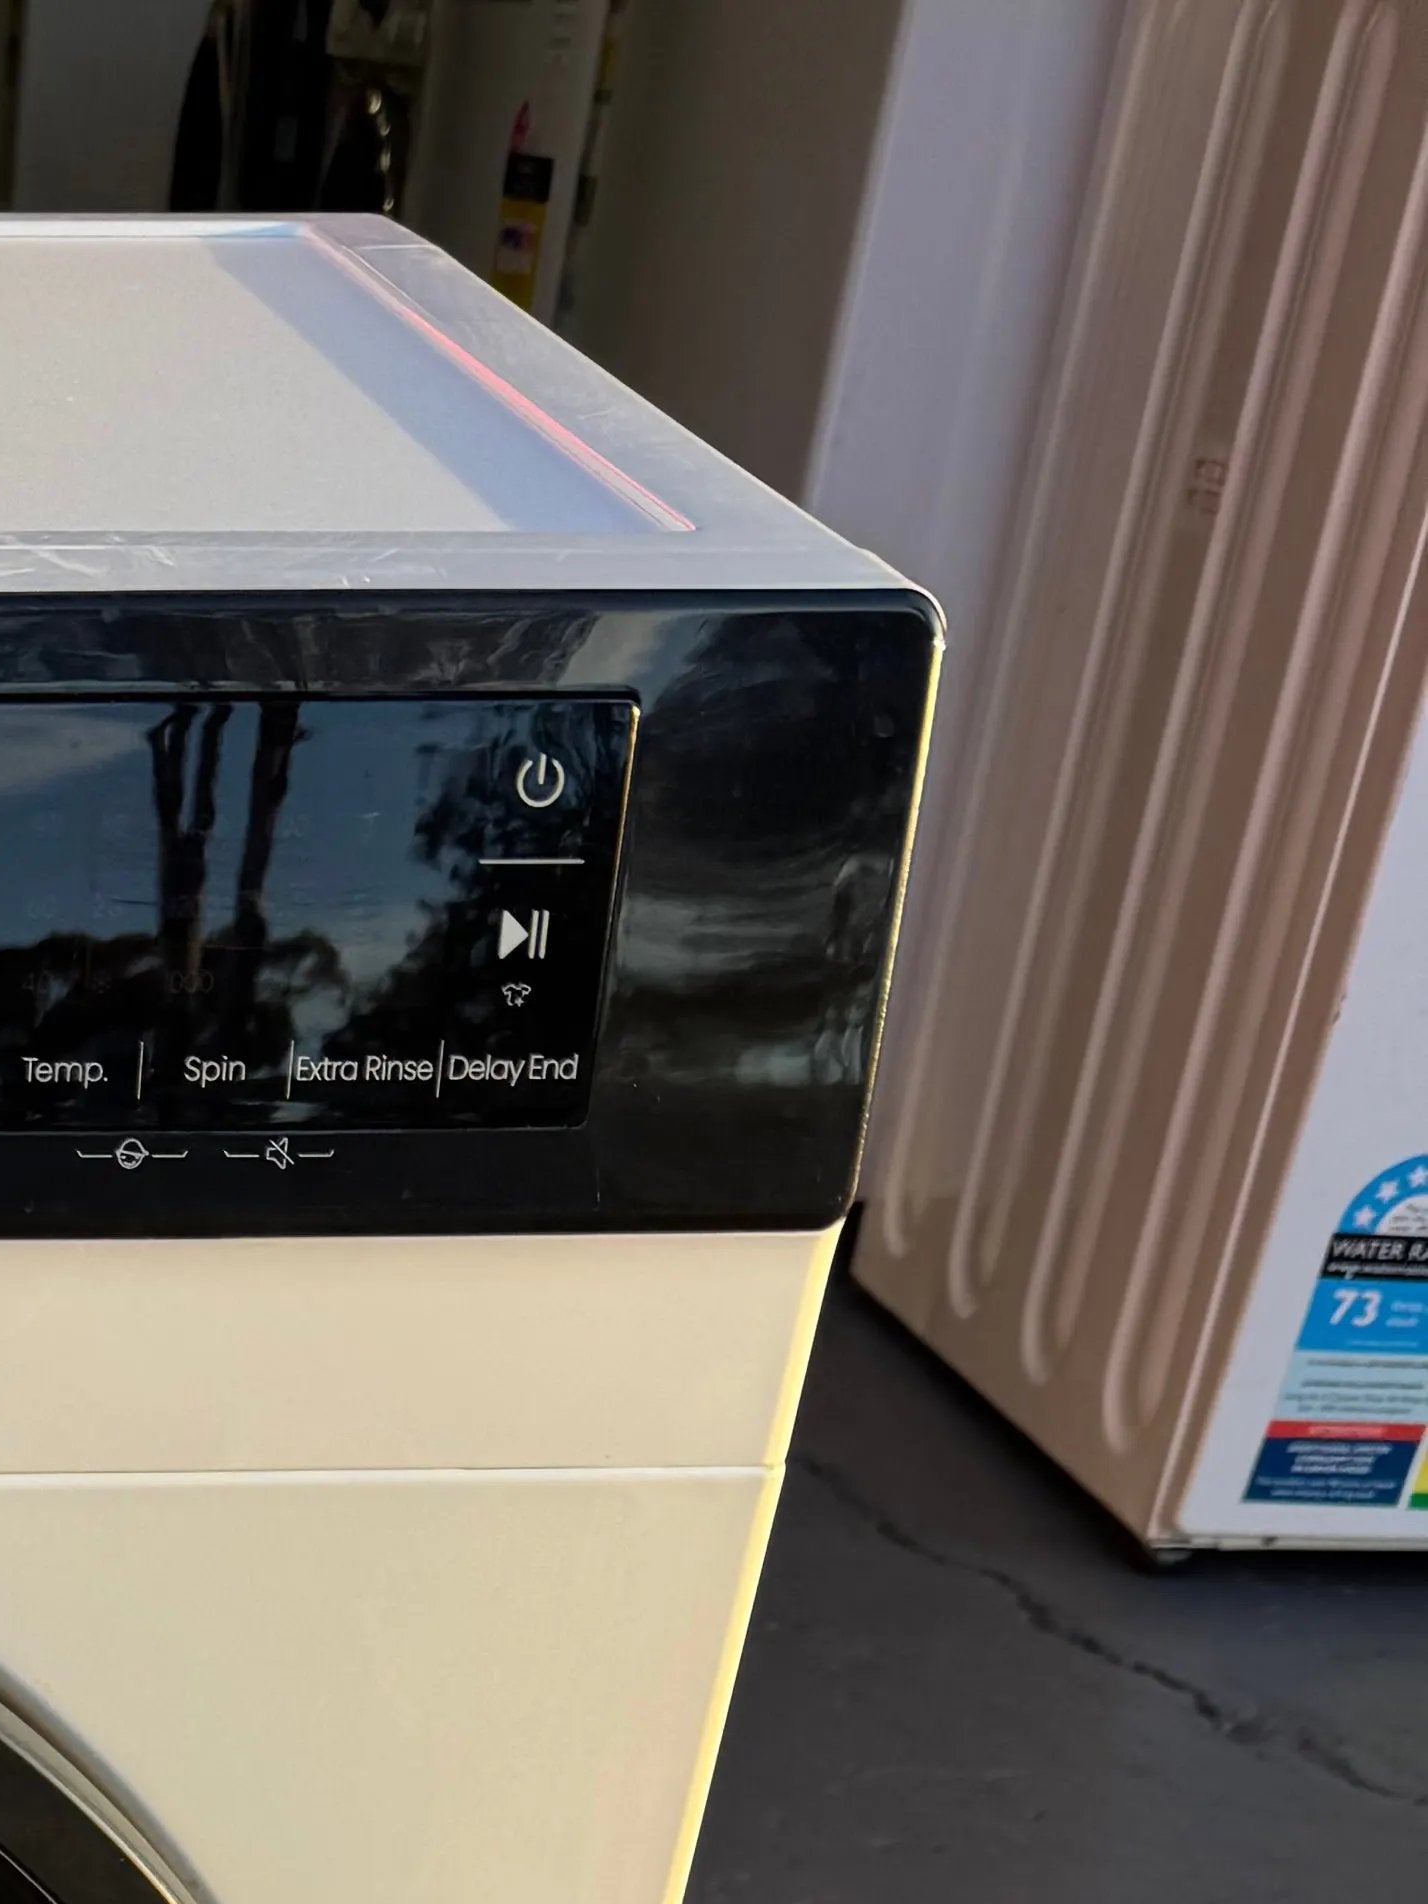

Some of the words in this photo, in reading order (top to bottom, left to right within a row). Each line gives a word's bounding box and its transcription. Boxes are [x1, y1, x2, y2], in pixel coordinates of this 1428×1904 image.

[22, 1057, 109, 1090] Temp.
[184, 1055, 245, 1087] Spin
[296, 1055, 357, 1081] Extra
[365, 1054, 434, 1081] Rinse
[448, 1054, 530, 1087] Delay
[529, 1053, 579, 1081] End
[1332, 1240, 1404, 1260] WATER
[1329, 1288, 1382, 1327] 73
